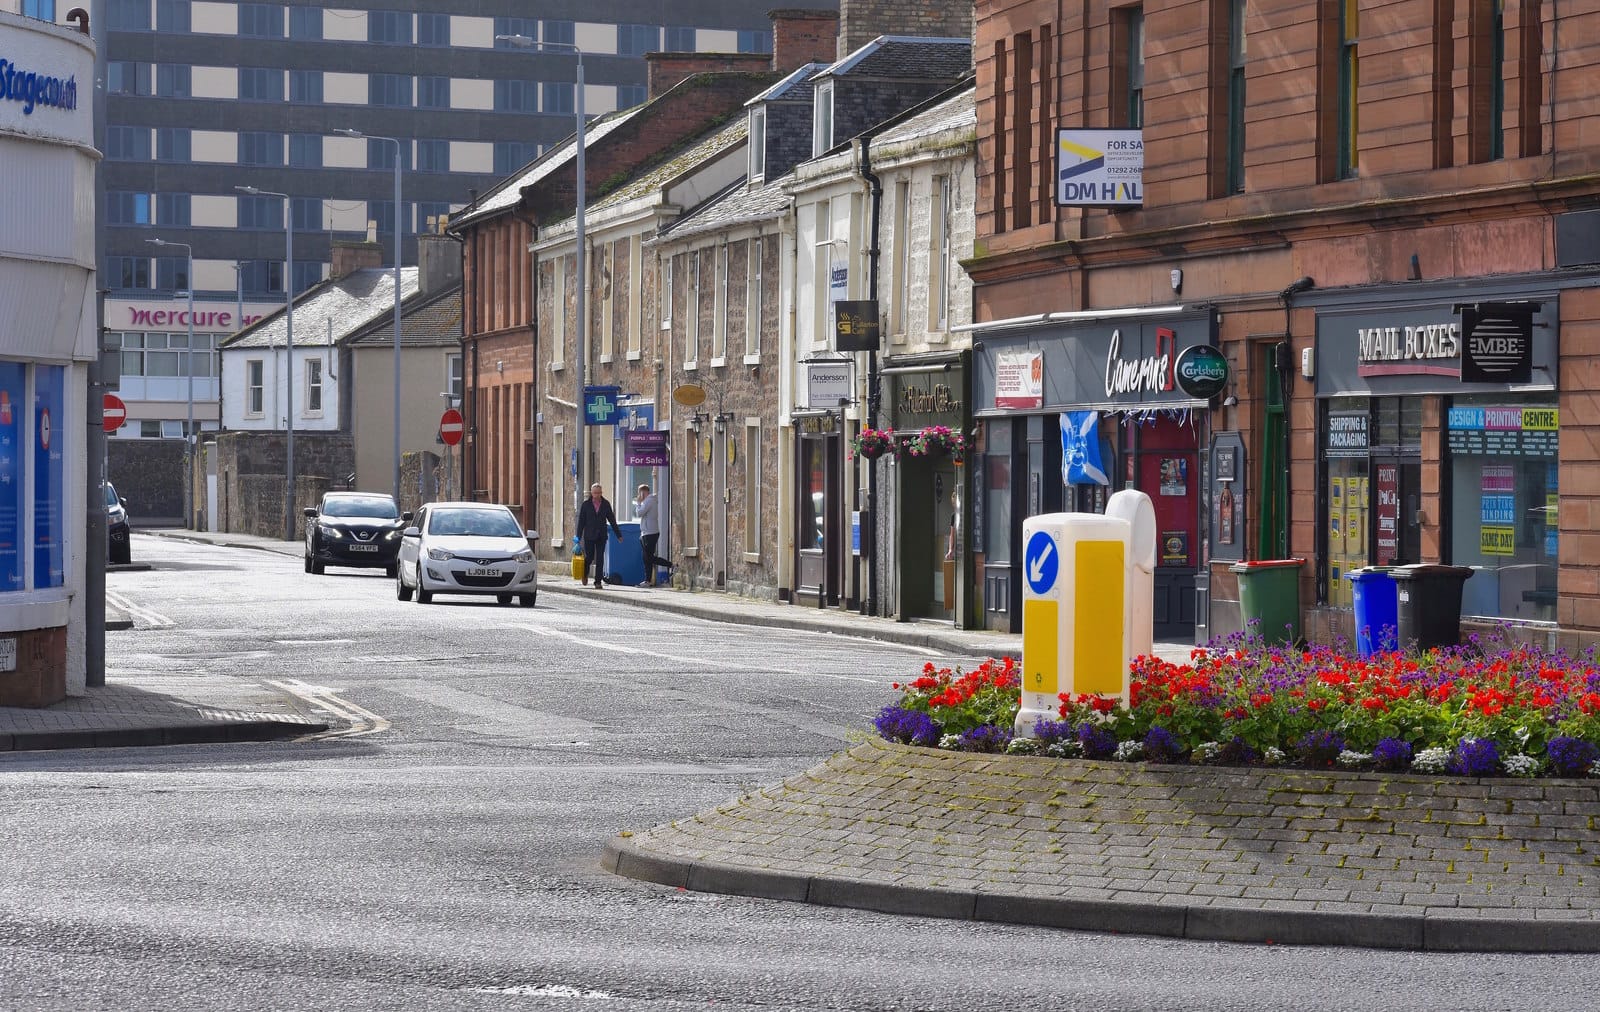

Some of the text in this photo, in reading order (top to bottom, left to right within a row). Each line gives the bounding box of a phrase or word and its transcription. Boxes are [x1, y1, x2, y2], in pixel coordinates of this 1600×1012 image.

[1107, 140, 1143, 149] FOR SA
[1065, 182, 1097, 200] DM
[128, 306, 232, 327] mercure
[1358, 323, 1458, 361] MAIL BOXES
[1477, 338, 1519, 354] MBE
[1105, 329, 1169, 398] Camerons
[1181, 362, 1225, 379] Carlsberg
[1330, 416, 1366, 431] SHIPPING &
[1448, 411, 1477, 426] DESIGN
[1478, 411, 1485, 426] &
[1486, 411, 1522, 427] PRINTING
[1330, 432, 1366, 446] PACKAGING
[646, 456, 663, 464] Sale
[1500, 534, 1513, 548] DAY
